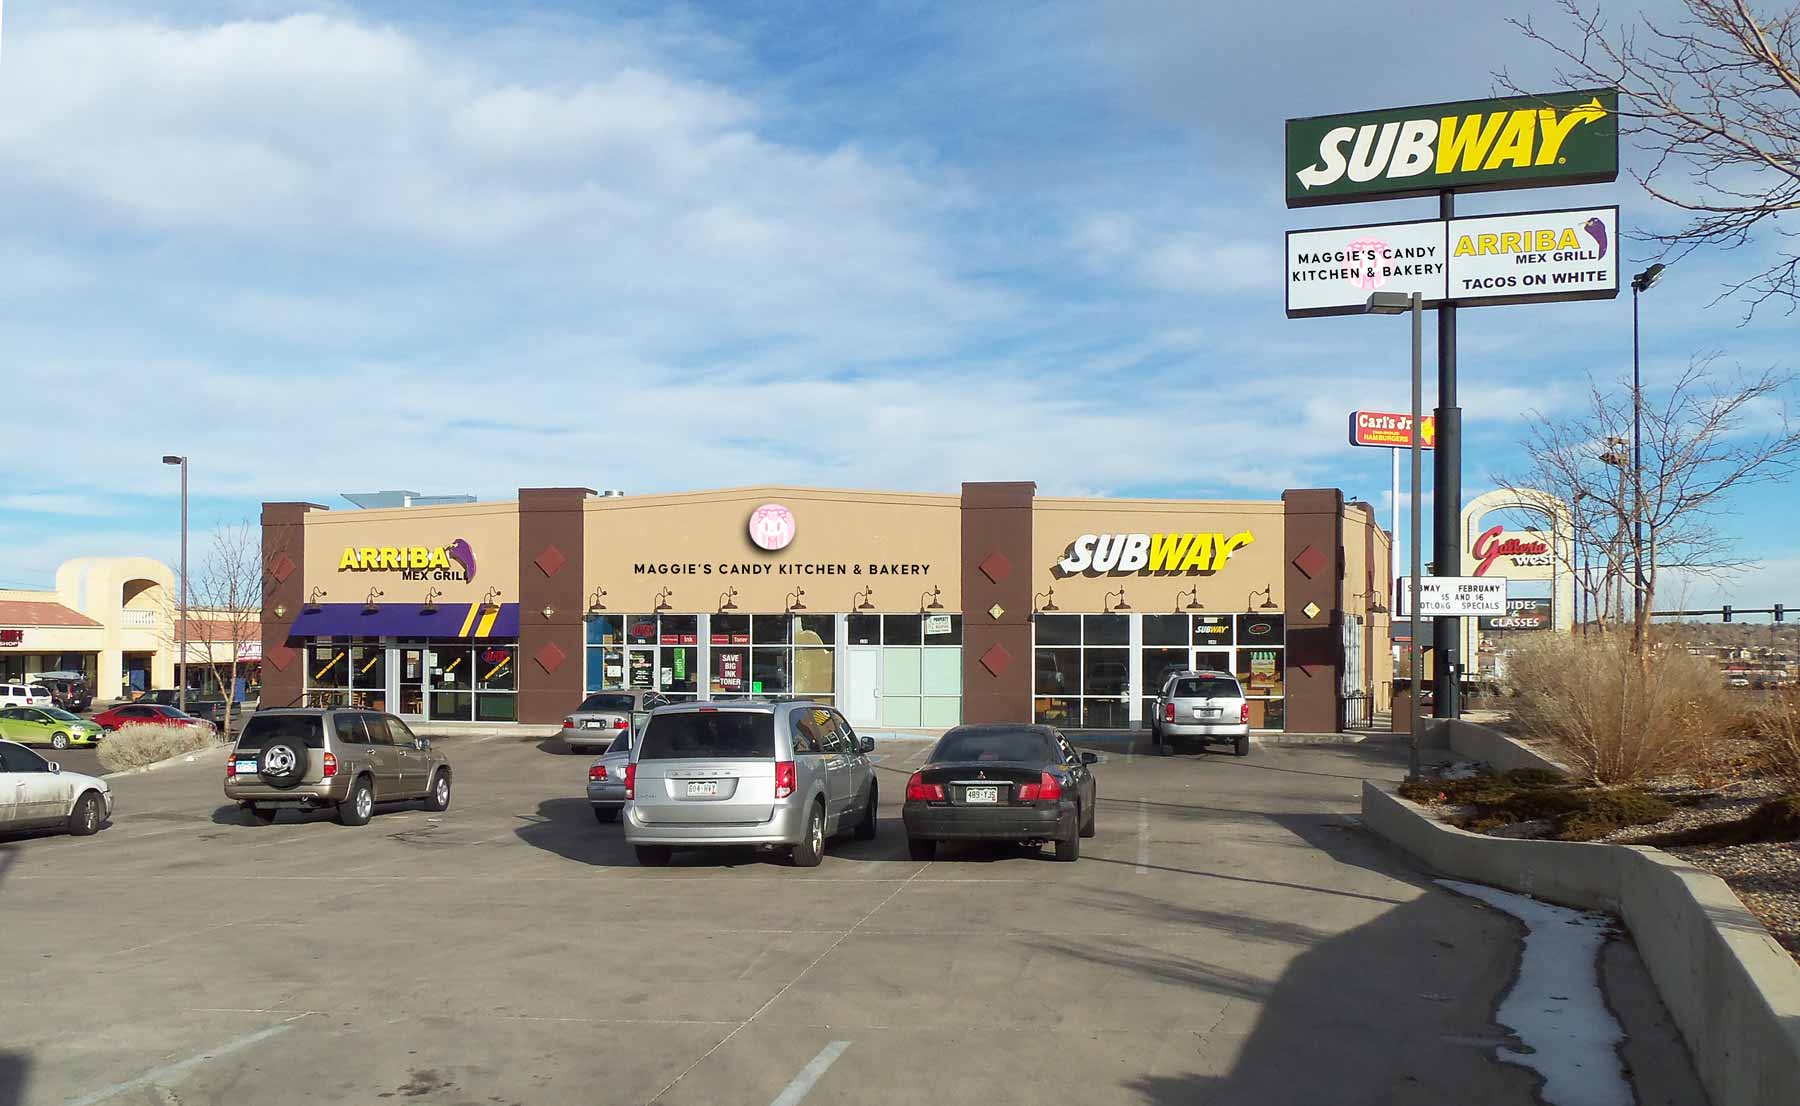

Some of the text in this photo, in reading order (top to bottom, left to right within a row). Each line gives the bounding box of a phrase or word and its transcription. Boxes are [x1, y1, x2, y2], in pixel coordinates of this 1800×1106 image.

[1296, 97, 1608, 190] SUBWAY
[1453, 228, 1580, 257] ARRIBA
[1298, 247, 1437, 264] MAGGIE'S CANDY
[1515, 250, 1597, 265] MEX GRILL
[1292, 263, 1443, 282] KITCHEN & BAKERY
[1462, 270, 1607, 290] TACOS ON WHITE
[1359, 415, 1395, 429] Carl's
[338, 547, 450, 570] ARRIBA
[1060, 530, 1255, 574] SUBWAY
[1472, 525, 1548, 577] Galleria
[402, 571, 468, 581] MEX GRILL
[634, 563, 930, 575] MAGGIE'S CANDY KITCHEN & BAKERY
[1505, 601, 1536, 610] UIDES
[1195, 626, 1229, 634] SUBWAY
[1490, 618, 1539, 627] CLASSES
